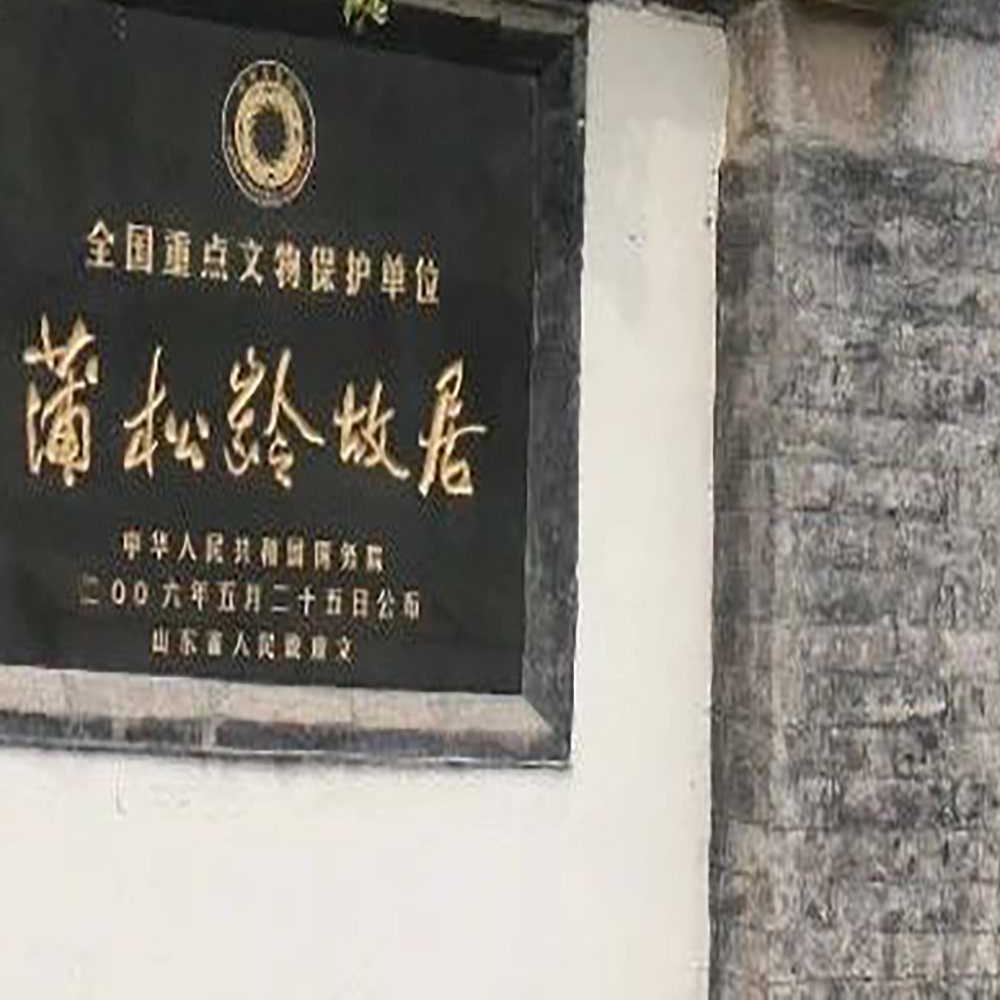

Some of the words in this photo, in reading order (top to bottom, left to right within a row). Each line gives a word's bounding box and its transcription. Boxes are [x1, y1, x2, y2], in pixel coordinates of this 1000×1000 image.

[86, 220, 439, 303] 全国重点文物保护单位
[24, 313, 487, 497] 蒲松龄故居
